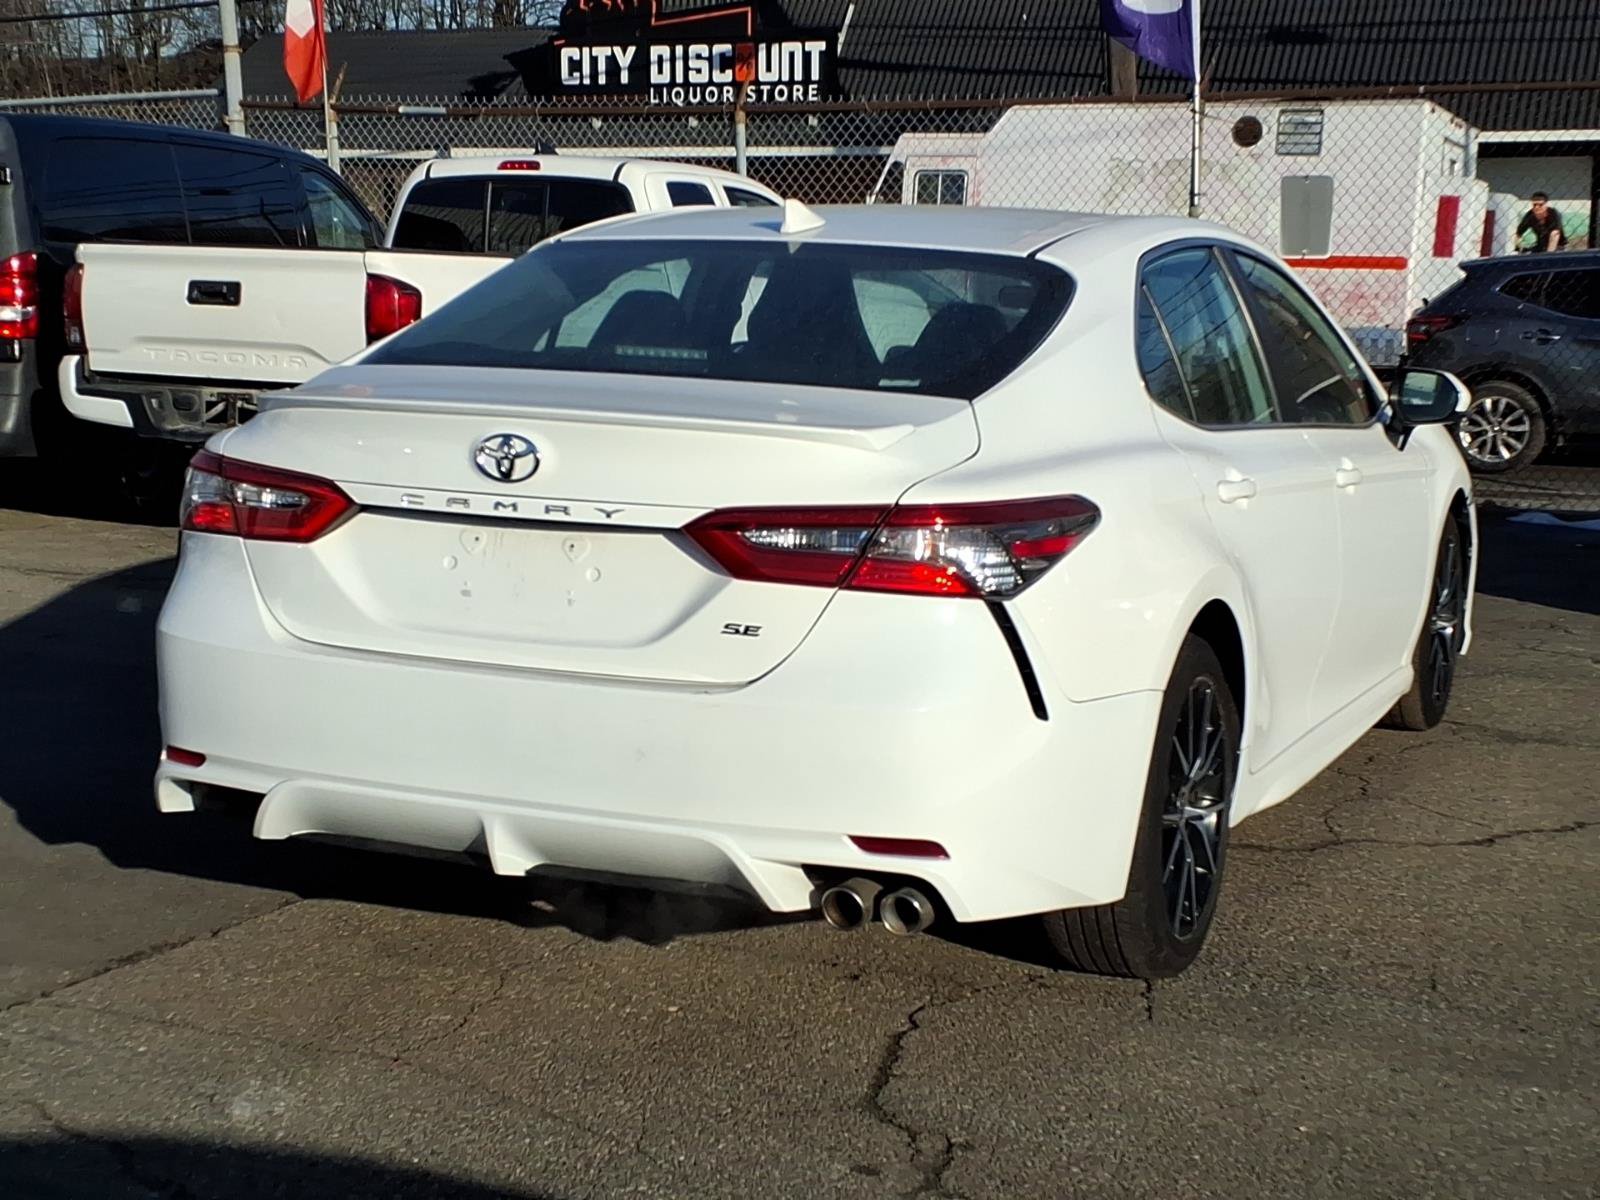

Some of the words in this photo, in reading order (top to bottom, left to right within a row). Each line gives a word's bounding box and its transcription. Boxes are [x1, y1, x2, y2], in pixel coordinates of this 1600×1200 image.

[561, 45, 636, 85] CITY
[650, 86, 735, 106] LIQUOR
[747, 84, 819, 103] STORE
[143, 347, 308, 368] TACOMA
[401, 493, 624, 518] CAMRY
[720, 623, 763, 637] SE
